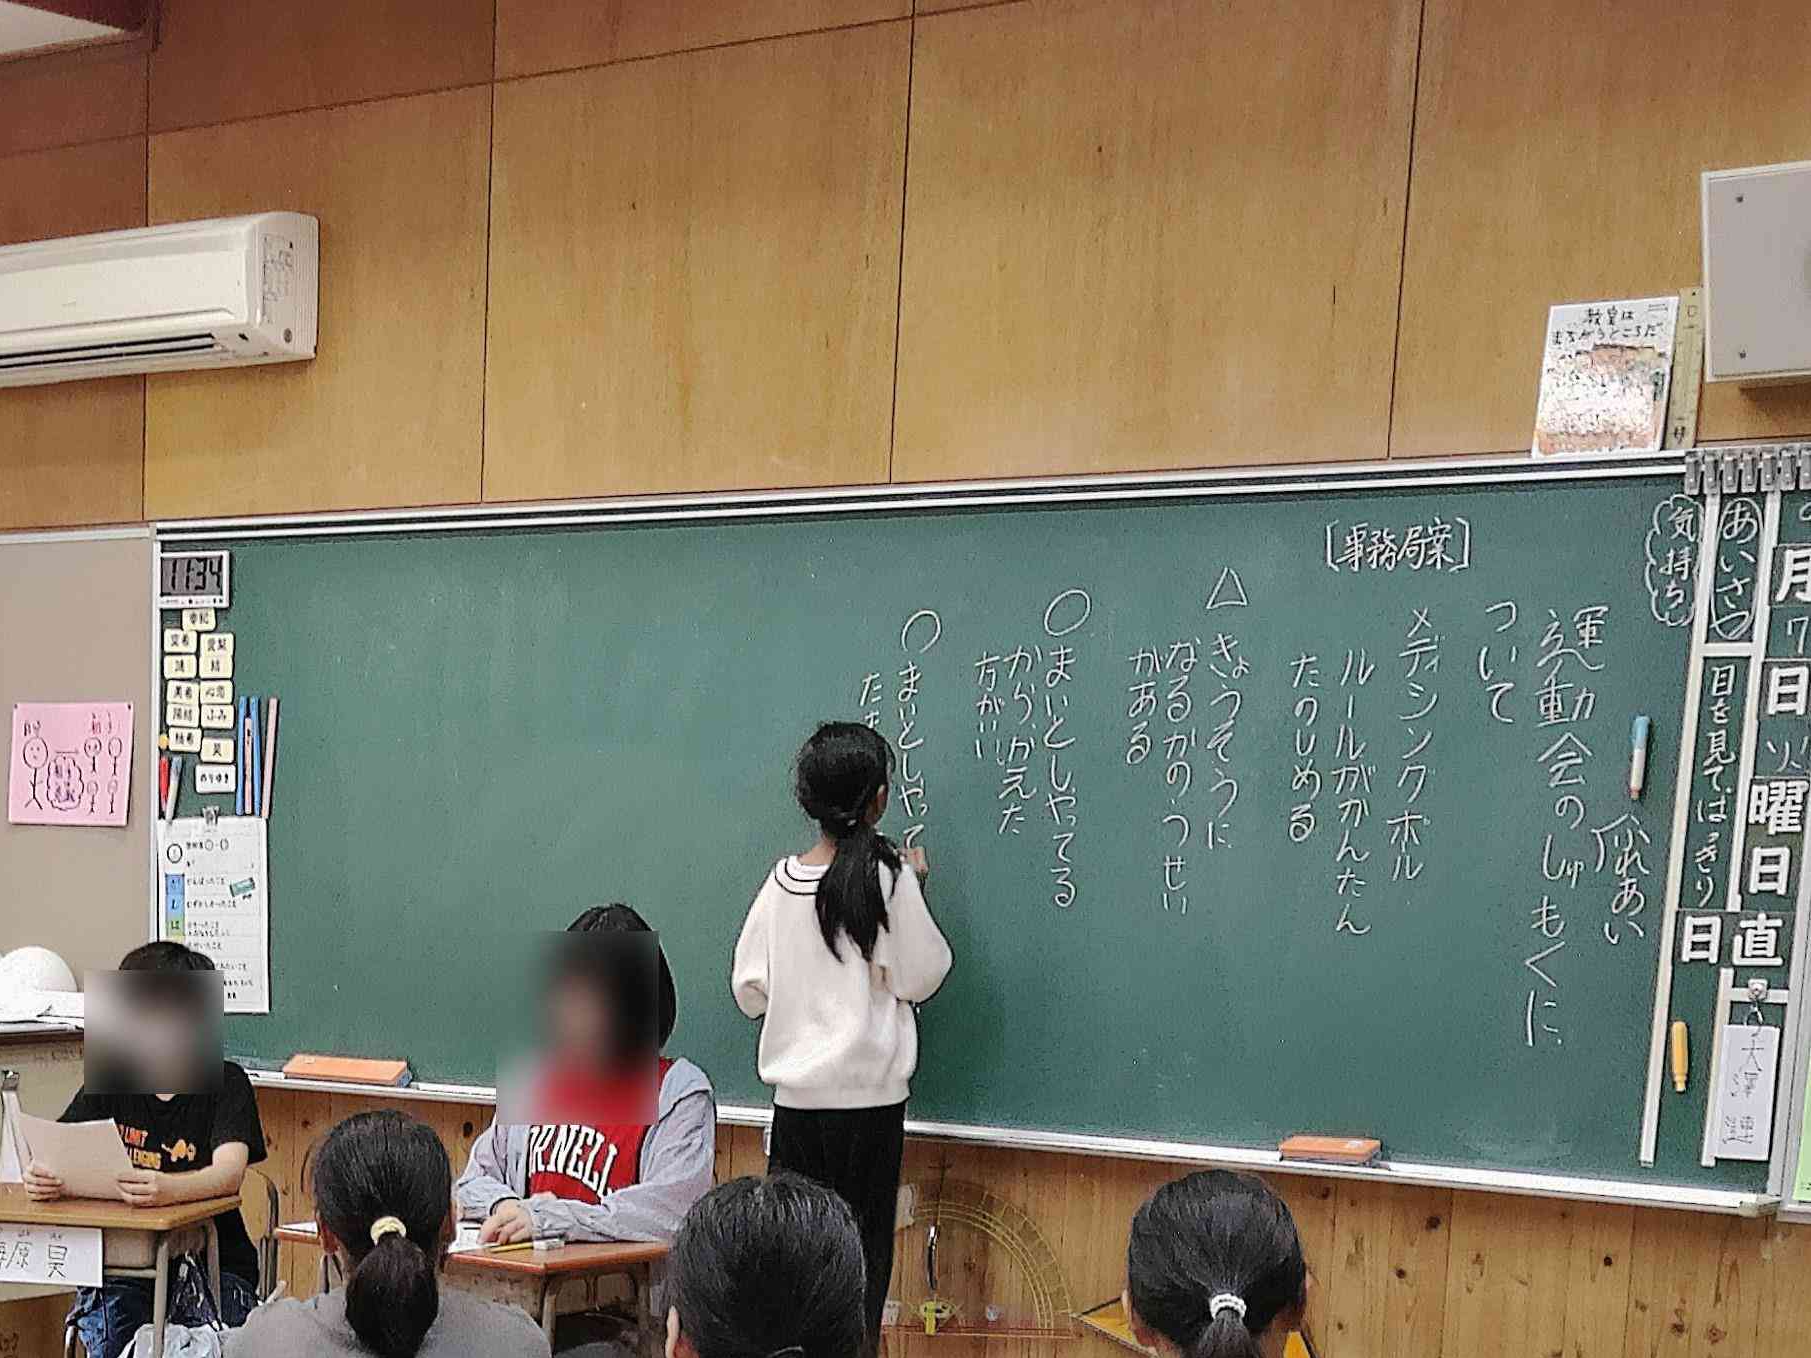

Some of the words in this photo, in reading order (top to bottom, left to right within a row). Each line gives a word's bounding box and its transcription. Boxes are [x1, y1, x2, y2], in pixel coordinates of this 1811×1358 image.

[1658, 506, 1695, 609] 気持ち
[1710, 502, 1758, 637] あいさつ
[1125, 647, 1161, 765] がある
[1206, 632, 1251, 849] きょうそうに
[1289, 652, 1322, 843] たのしめる
[1479, 601, 1517, 723] ついて
[1044, 646, 1080, 908] まいとしやってる
[1162, 637, 1201, 915] なるかのうせい
[1331, 648, 1376, 936] ルールがかんたん
